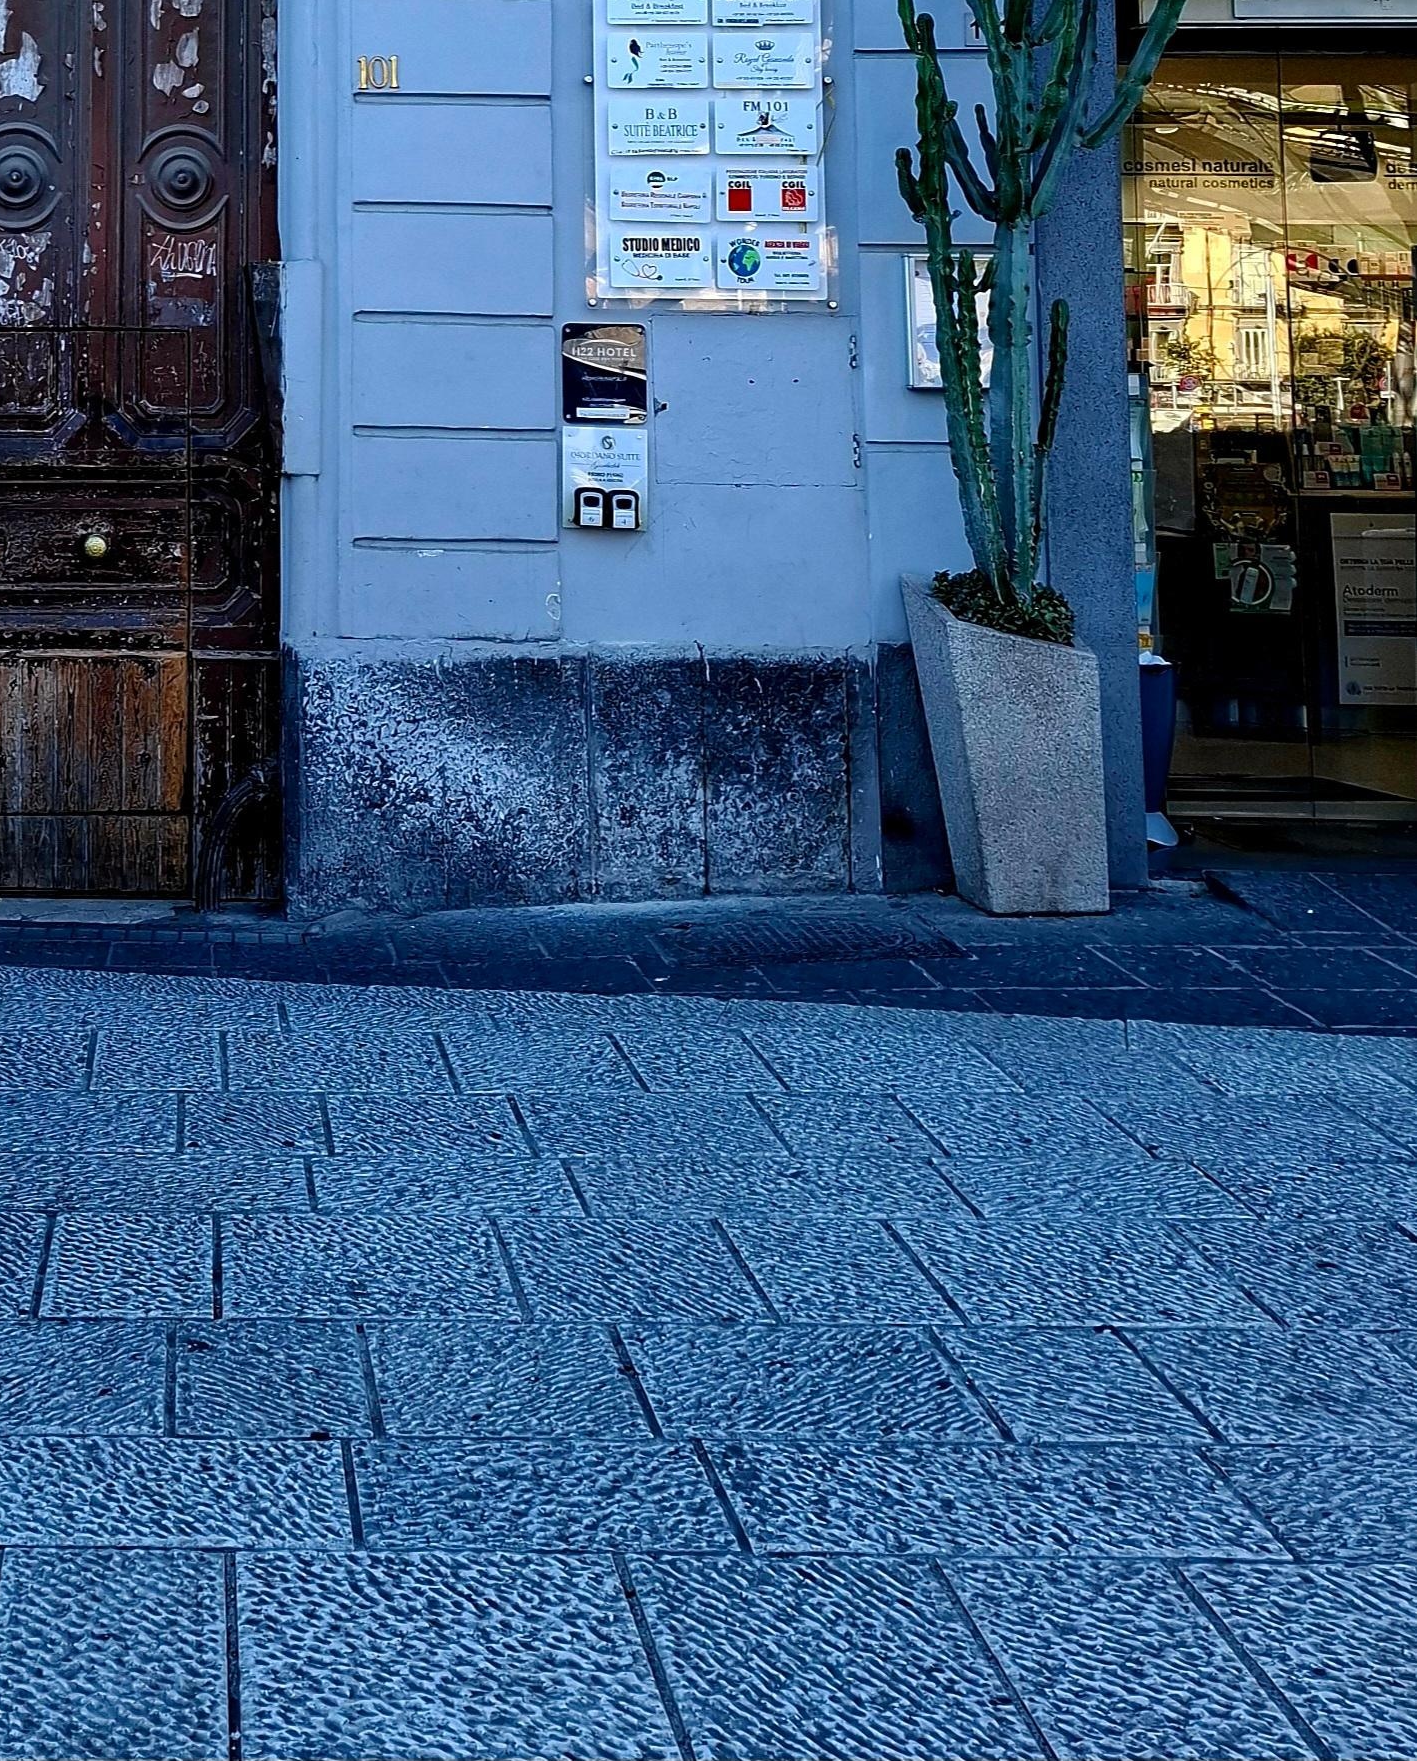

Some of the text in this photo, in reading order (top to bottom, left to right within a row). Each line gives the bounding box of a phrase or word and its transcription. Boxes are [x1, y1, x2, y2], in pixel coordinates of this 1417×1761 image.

[357, 54, 400, 90] 101
[743, 101, 789, 112] FM 101
[645, 107, 678, 119] B & B
[623, 124, 699, 136] SUITE BEATRICE
[1123, 158, 1273, 173] cosmesi naturale
[1149, 177, 1274, 188] natural cosmetics
[622, 237, 700, 251] STUDIO MEDICO
[571, 347, 637, 357] H22 HOTEL
[1342, 584, 1399, 597] Atoderm
